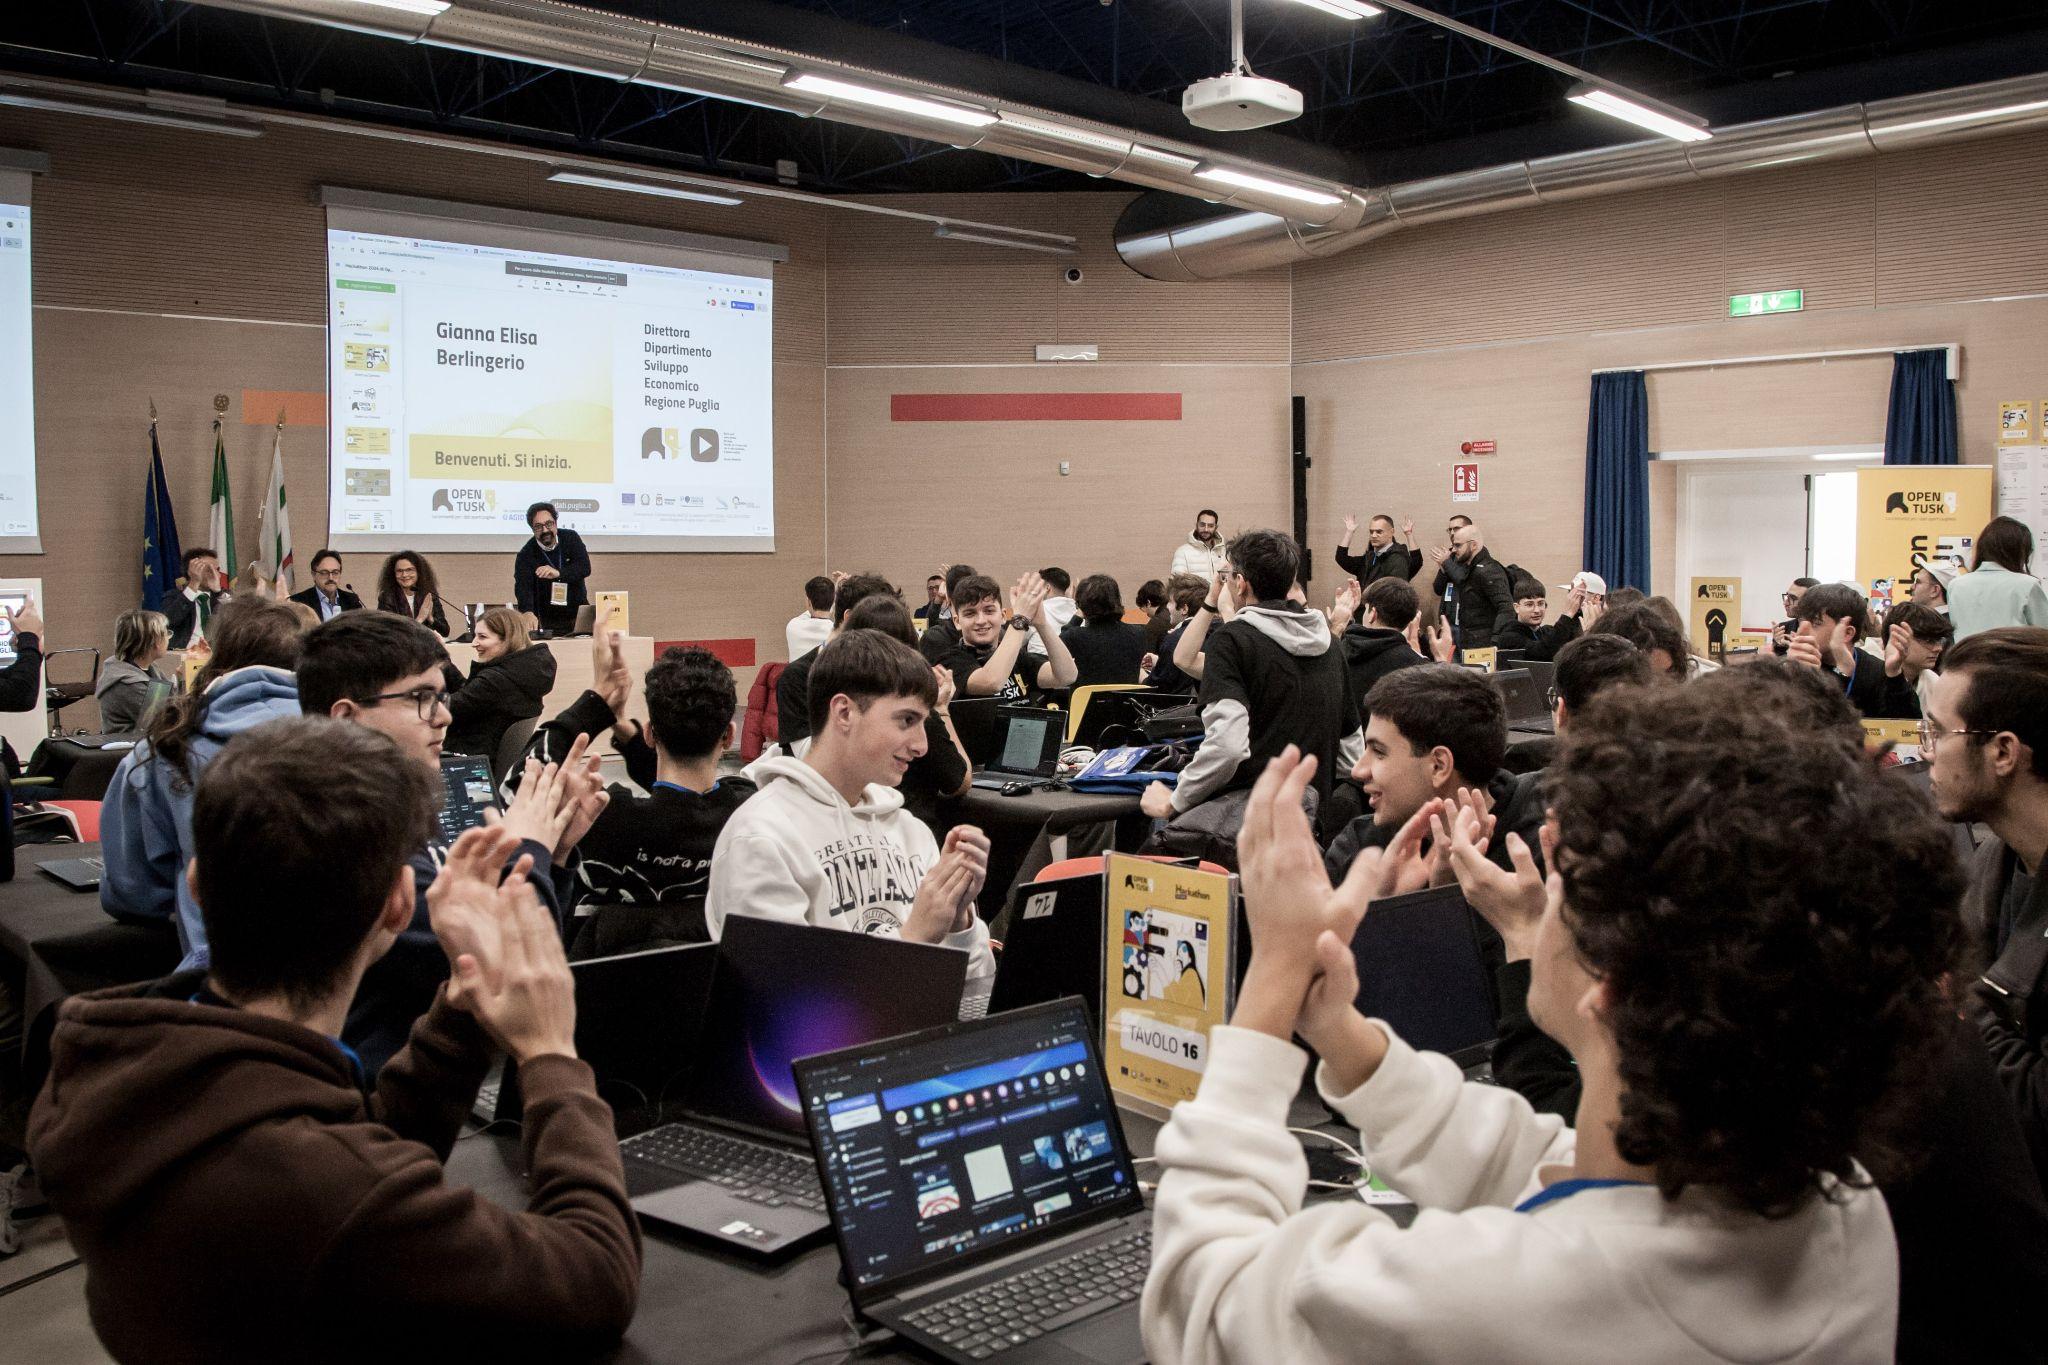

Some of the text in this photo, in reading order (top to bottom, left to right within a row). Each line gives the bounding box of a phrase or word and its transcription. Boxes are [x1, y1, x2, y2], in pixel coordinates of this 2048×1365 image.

[436, 321, 537, 345] Gianna Elisa
[644, 323, 690, 338] Direttora
[644, 341, 712, 357] Dipartimento
[437, 348, 524, 373] Berlingerio
[644, 359, 689, 375] Sviluppo
[644, 377, 699, 391] Economico
[644, 395, 720, 413] Regione Puglia
[435, 450, 572, 469] Benvenuti. Si inizia.
[451, 488, 482, 499] OPEN
[1907, 491, 1941, 502] OPEN
[456, 501, 485, 512] TUSK
[1912, 504, 1944, 513] TUSK
[637, 847, 648, 861] is
[653, 854, 683, 866] not
[681, 859, 693, 868] a
[1175, 884, 1210, 900] Hackathon
[1129, 1024, 1199, 1060] TAVOLO 16
